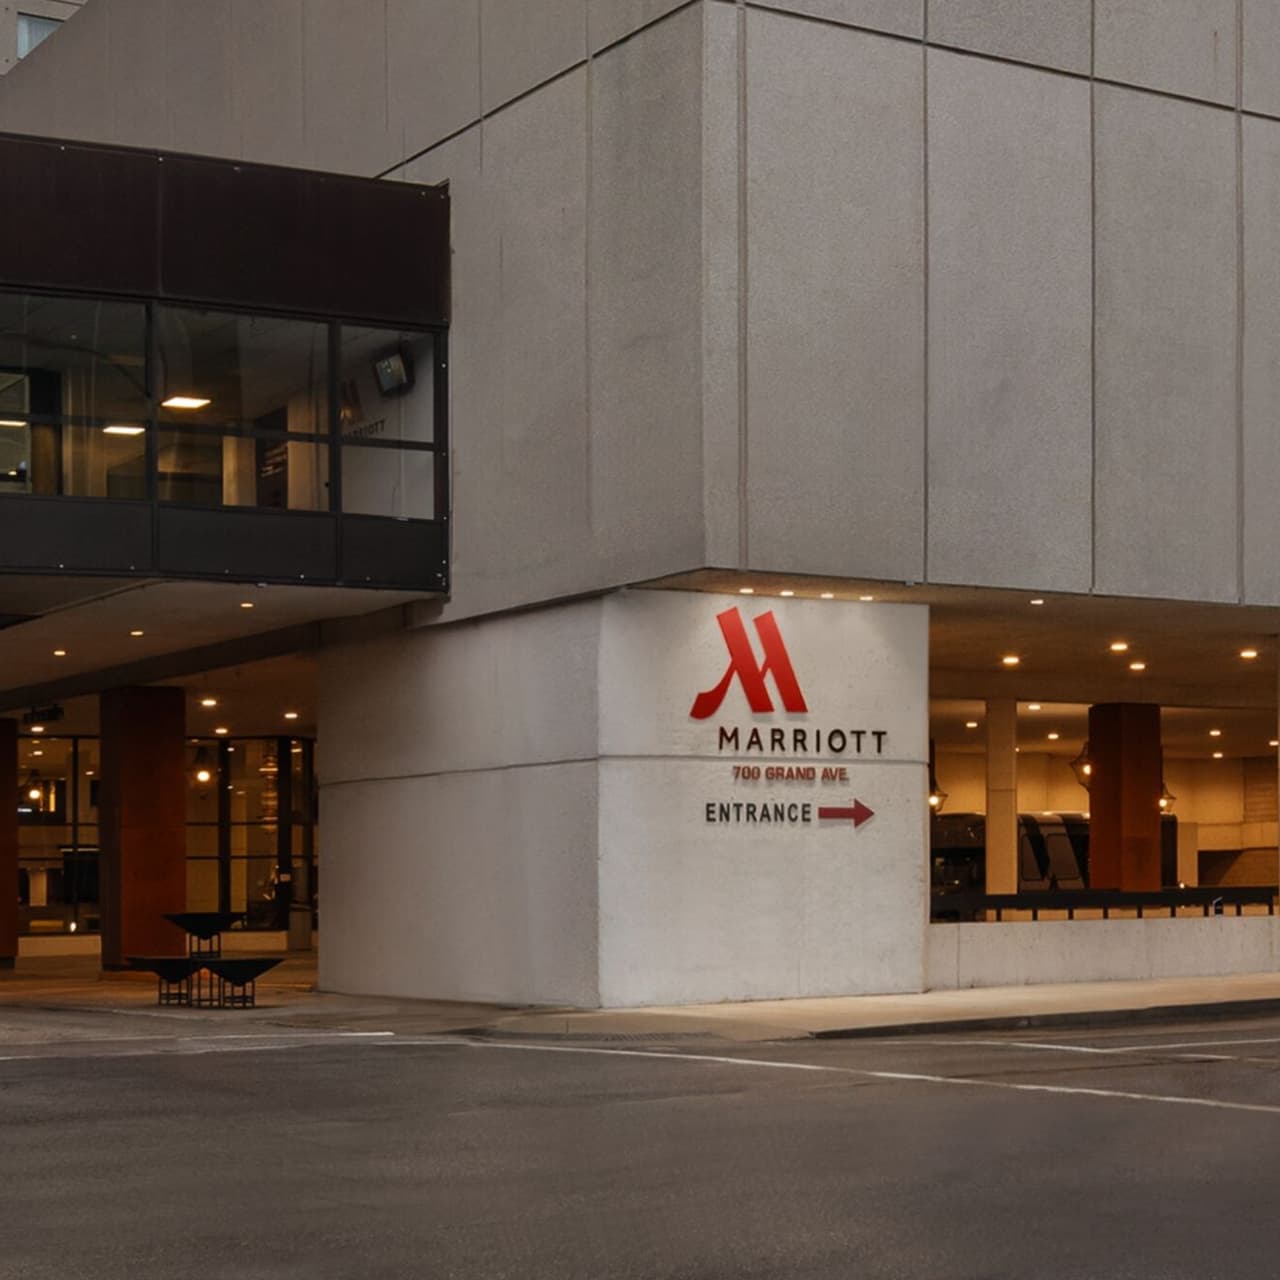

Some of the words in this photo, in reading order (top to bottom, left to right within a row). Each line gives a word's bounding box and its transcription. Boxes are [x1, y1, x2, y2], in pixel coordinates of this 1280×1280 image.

[719, 726, 887, 753] MARRIOTT
[733, 766, 760, 780] 700
[765, 767, 816, 781] GRAND
[821, 767, 849, 781] AVE.
[705, 803, 812, 822] ENTRANCE
